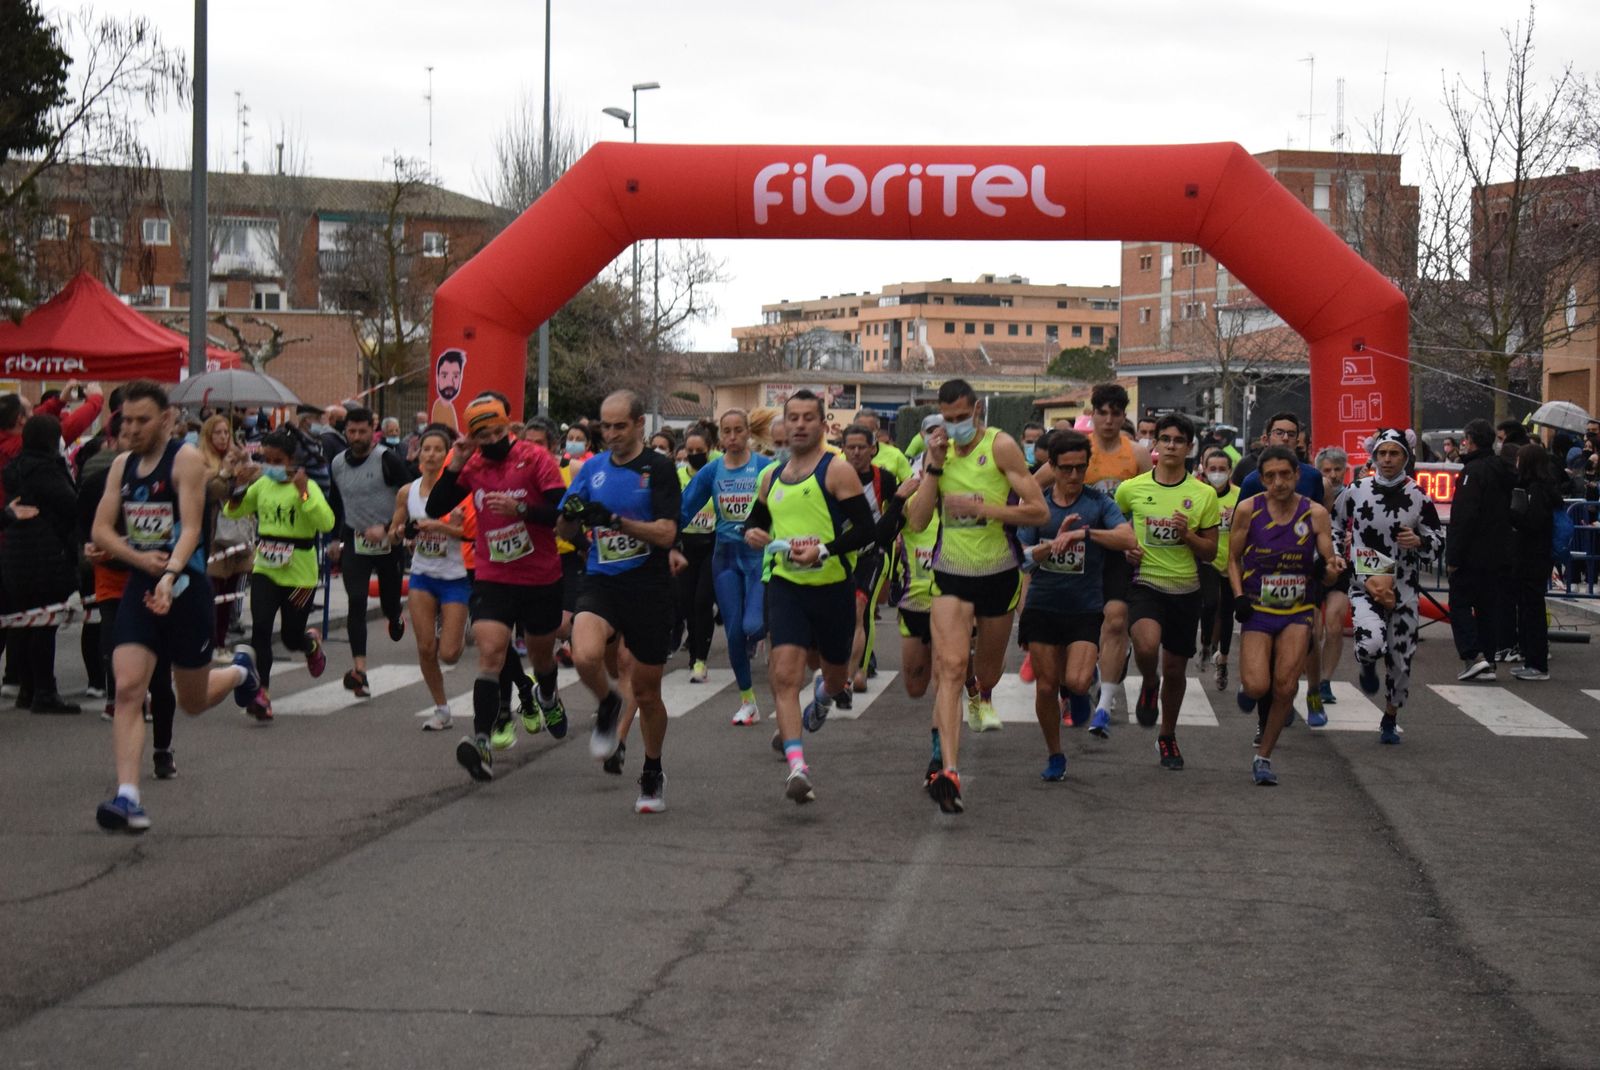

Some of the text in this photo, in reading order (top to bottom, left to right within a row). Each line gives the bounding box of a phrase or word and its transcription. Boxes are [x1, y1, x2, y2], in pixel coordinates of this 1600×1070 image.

[726, 504, 748, 514] 408
[134, 516, 162, 532] 442
[1153, 527, 1179, 540] 420
[496, 536, 522, 553] 475
[607, 536, 637, 552] 488
[1048, 552, 1076, 565] 483
[1270, 586, 1297, 599] 401
